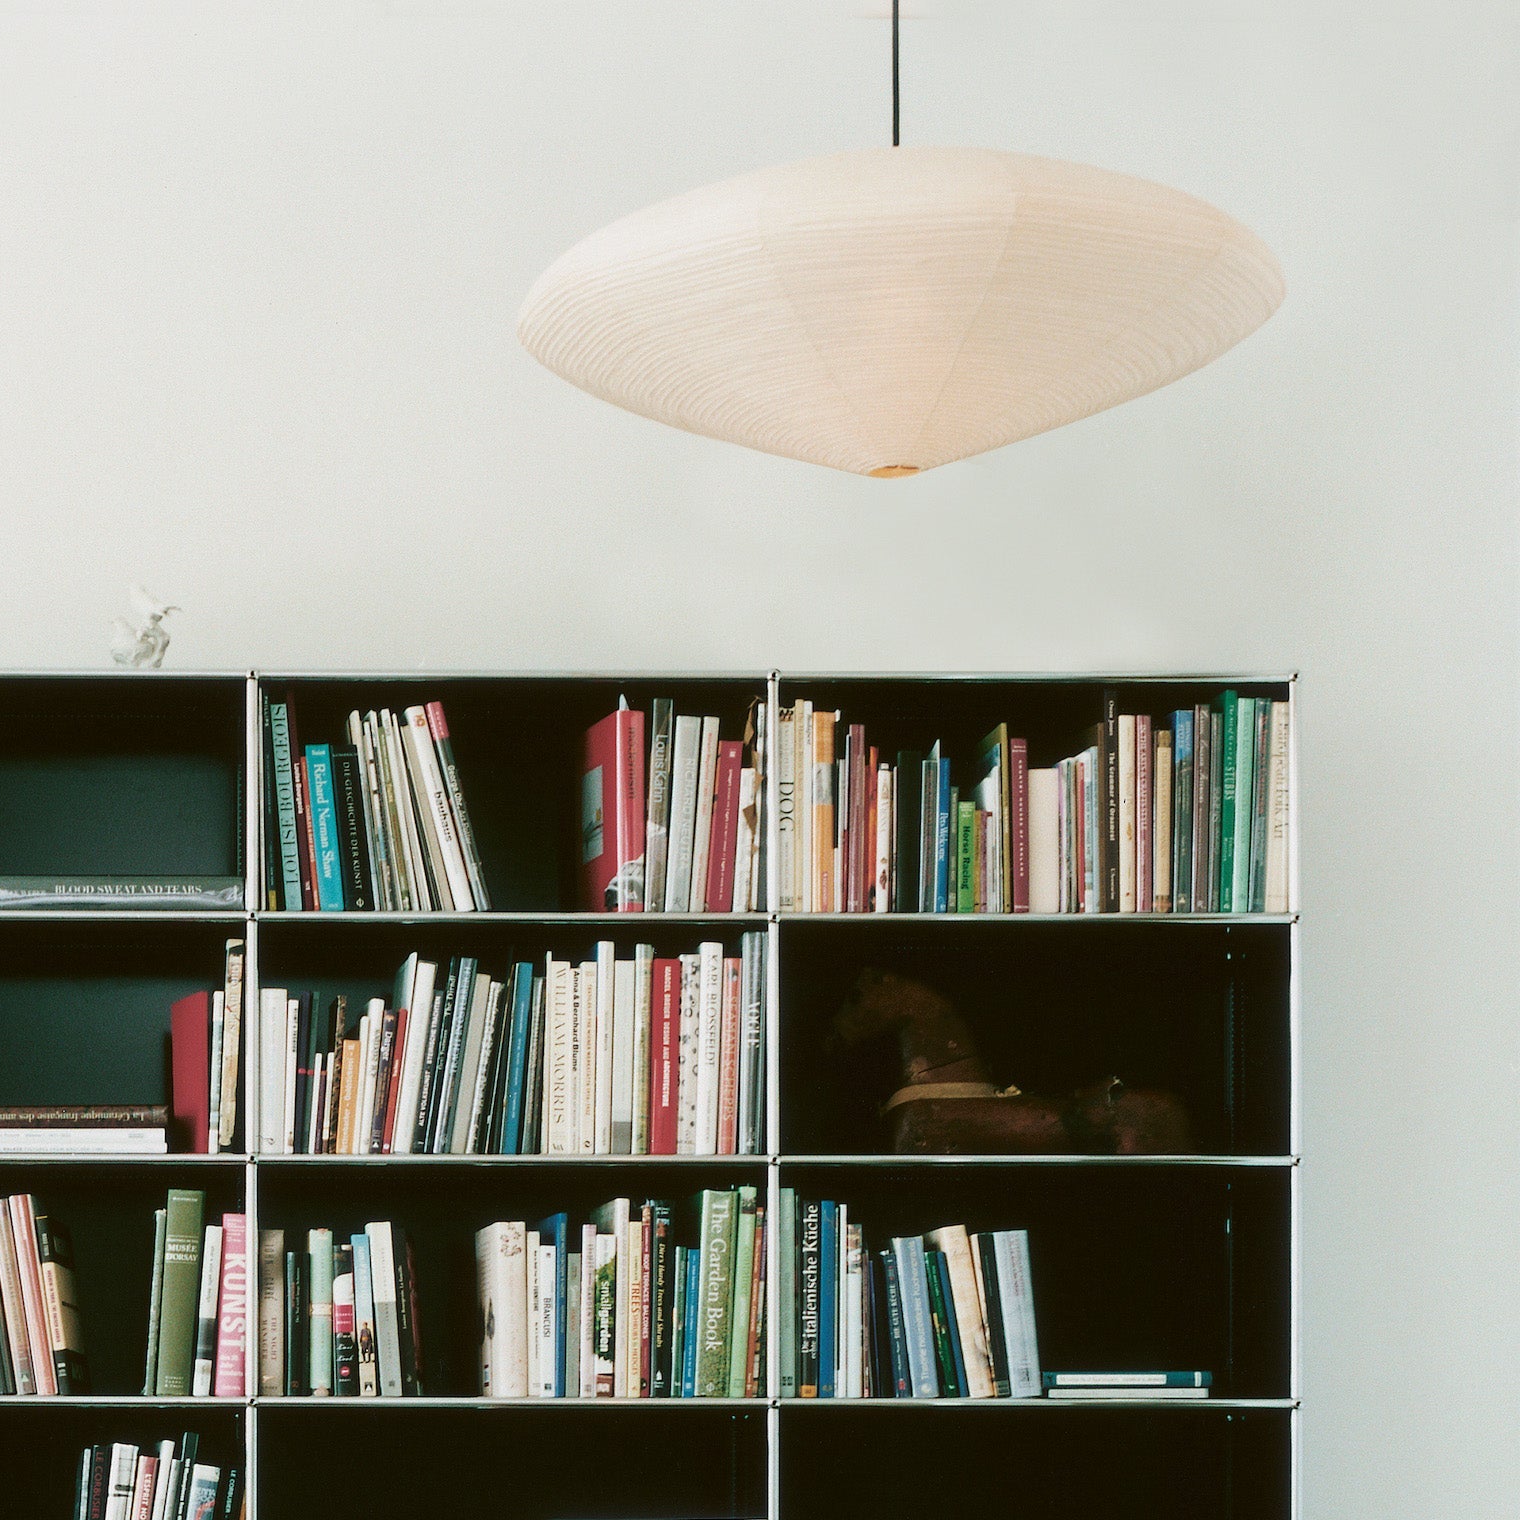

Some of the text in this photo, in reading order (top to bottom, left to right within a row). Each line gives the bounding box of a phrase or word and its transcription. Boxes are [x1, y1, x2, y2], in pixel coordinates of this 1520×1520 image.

[653, 734, 668, 803] Louis Kahn
[1224, 766, 1235, 801] STUBBS
[273, 706, 298, 884] LOUISE BOURGEOIS
[779, 781, 795, 832] DOG
[314, 763, 335, 878] Richard Norman Shaw
[960, 825, 971, 890] Horse Racing
[54, 885, 202, 895] BLOOD SWEAT AND TEARS
[571, 970, 580, 994] Anna
[708, 955, 718, 988] KARL
[381, 1031, 394, 1061] Darger
[551, 967, 567, 1125] WILLIAM MORRIS
[571, 1002, 580, 1044] Bernhard
[661, 966, 671, 1108] MARCEL DESIGN ARCHITECTURE
[747, 1000, 761, 1048] VOGUE
[571, 1044, 580, 1073] Blume
[18, 1113, 35, 1122] des
[132, 1113, 145, 1121] La
[704, 1199, 730, 1352] The Garden Book
[801, 1204, 819, 1339] italienische Küche
[221, 1252, 246, 1352] KUNST
[543, 1297, 552, 1338] BRANCUSI
[631, 1282, 641, 1313] TREES
[642, 1253, 651, 1340] ROOF TERRACES BALCONIES
[656, 1288, 665, 1348] Trees Shrubs
[91, 1451, 105, 1519] LE CORBUSIER
[142, 1473, 153, 1506] L'ESPRIT
[225, 1469, 237, 1514] LE CORBUSIER
